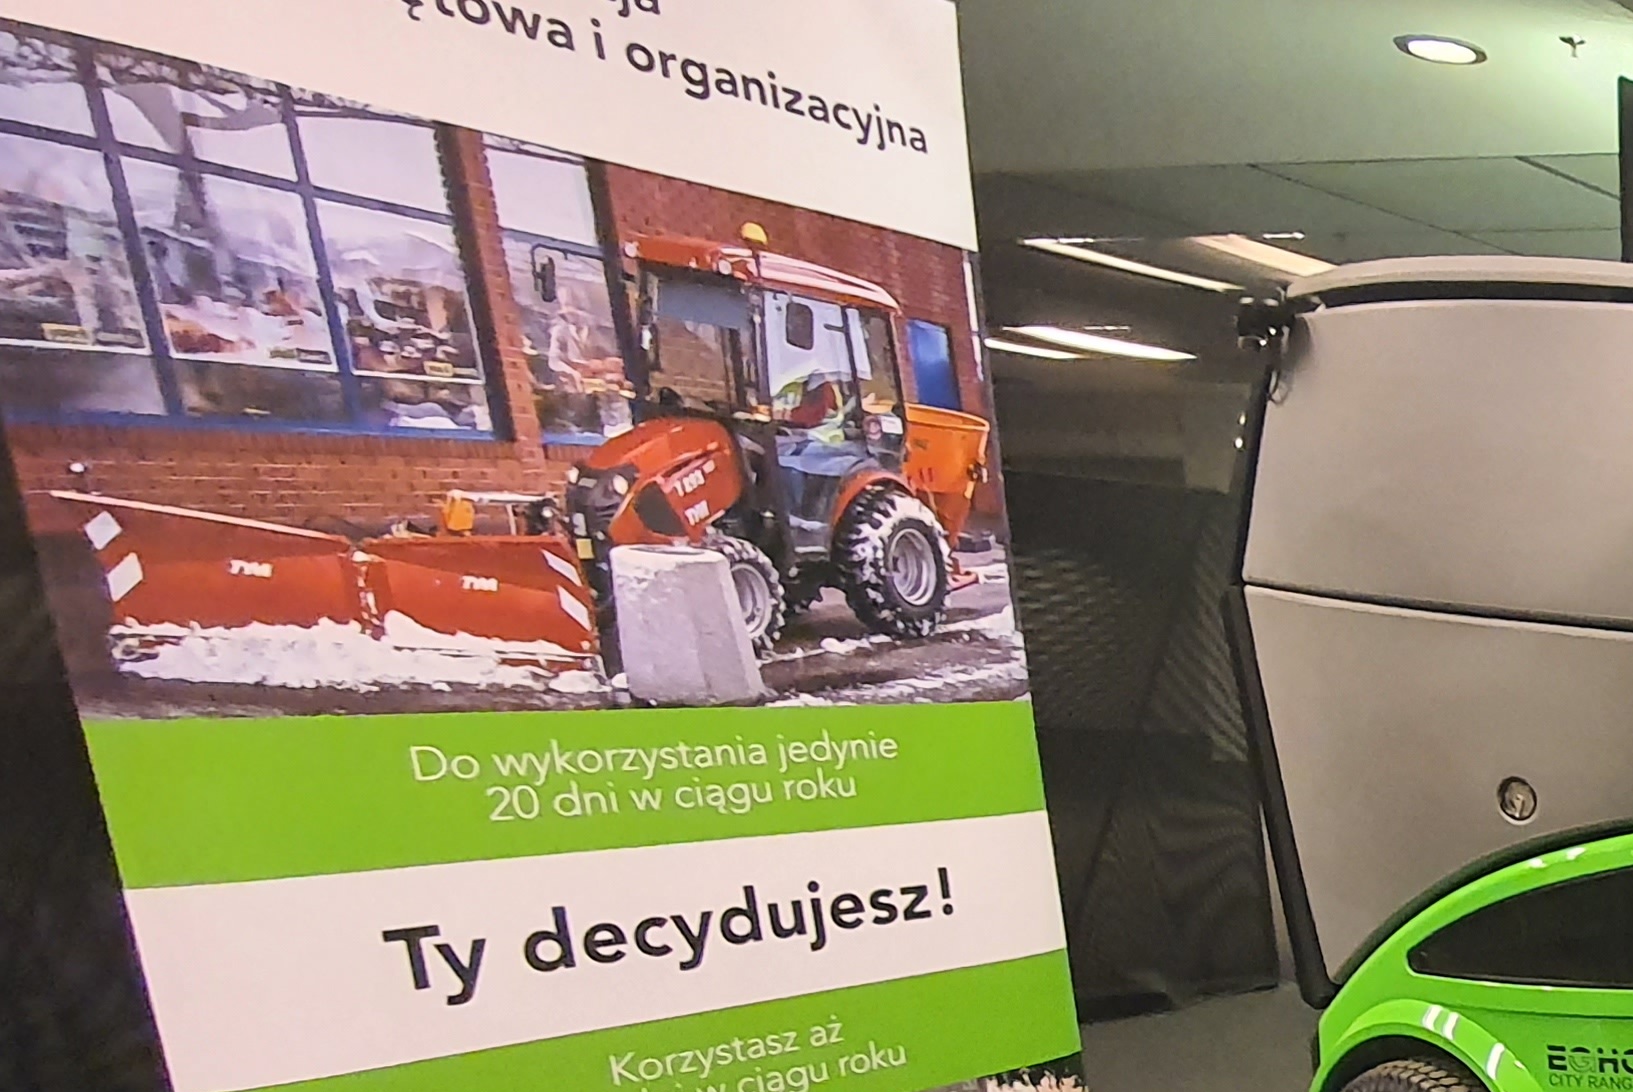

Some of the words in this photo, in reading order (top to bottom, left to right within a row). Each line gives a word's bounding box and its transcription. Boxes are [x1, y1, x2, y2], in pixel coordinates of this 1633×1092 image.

[406, 0, 575, 51] owa
[591, 17, 606, 60] i
[625, 41, 929, 153] organizacyjna
[409, 744, 480, 782] Do
[491, 735, 767, 786] wykorzystania
[777, 730, 899, 773] jedynie
[485, 785, 540, 822] 20
[552, 781, 619, 817] dni
[630, 784, 663, 812] w
[674, 778, 773, 816] ciągu
[783, 769, 858, 802] roku
[382, 925, 487, 1005] Ty
[523, 866, 955, 972] decydujesz!
[608, 1030, 800, 1087] Korzystasz
[808, 1014, 844, 1046] aż
[838, 1041, 907, 1079] roku
[1549, 1073, 1584, 1088] CITY
